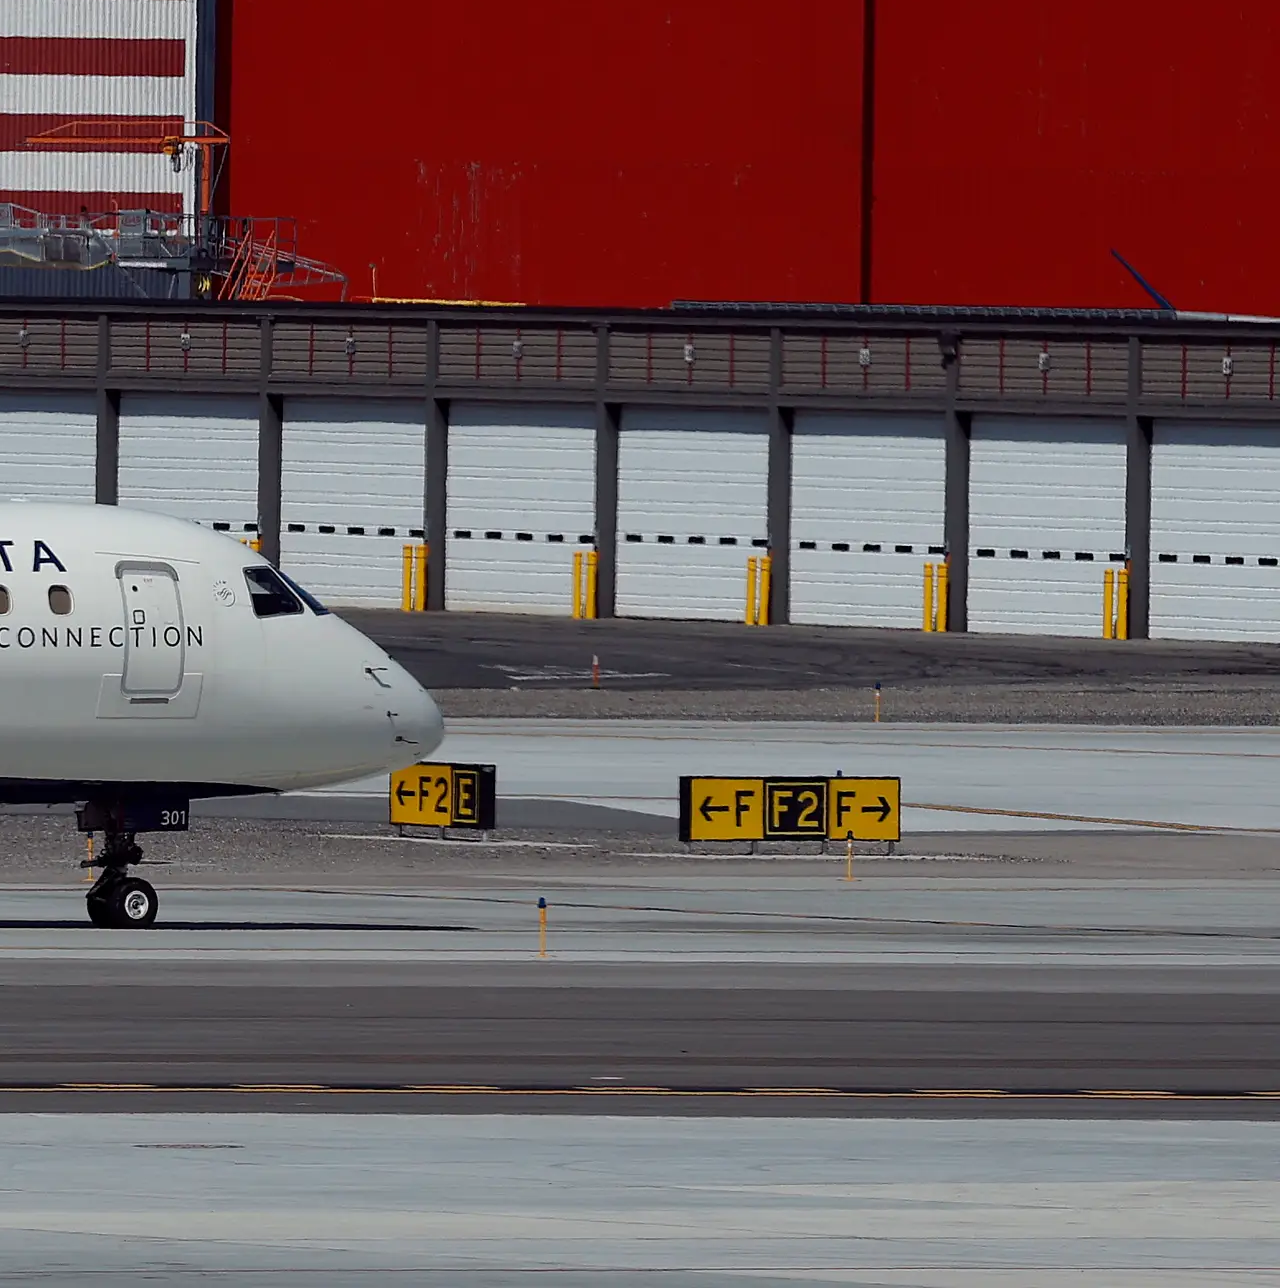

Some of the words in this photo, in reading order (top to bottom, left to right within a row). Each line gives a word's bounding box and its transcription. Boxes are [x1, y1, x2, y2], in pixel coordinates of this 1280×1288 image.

[418, 776, 448, 813] F2
[458, 778, 473, 816] E
[735, 790, 755, 828] F
[773, 790, 819, 829] F2
[836, 790, 856, 828] F
[160, 810, 186, 826] 301
